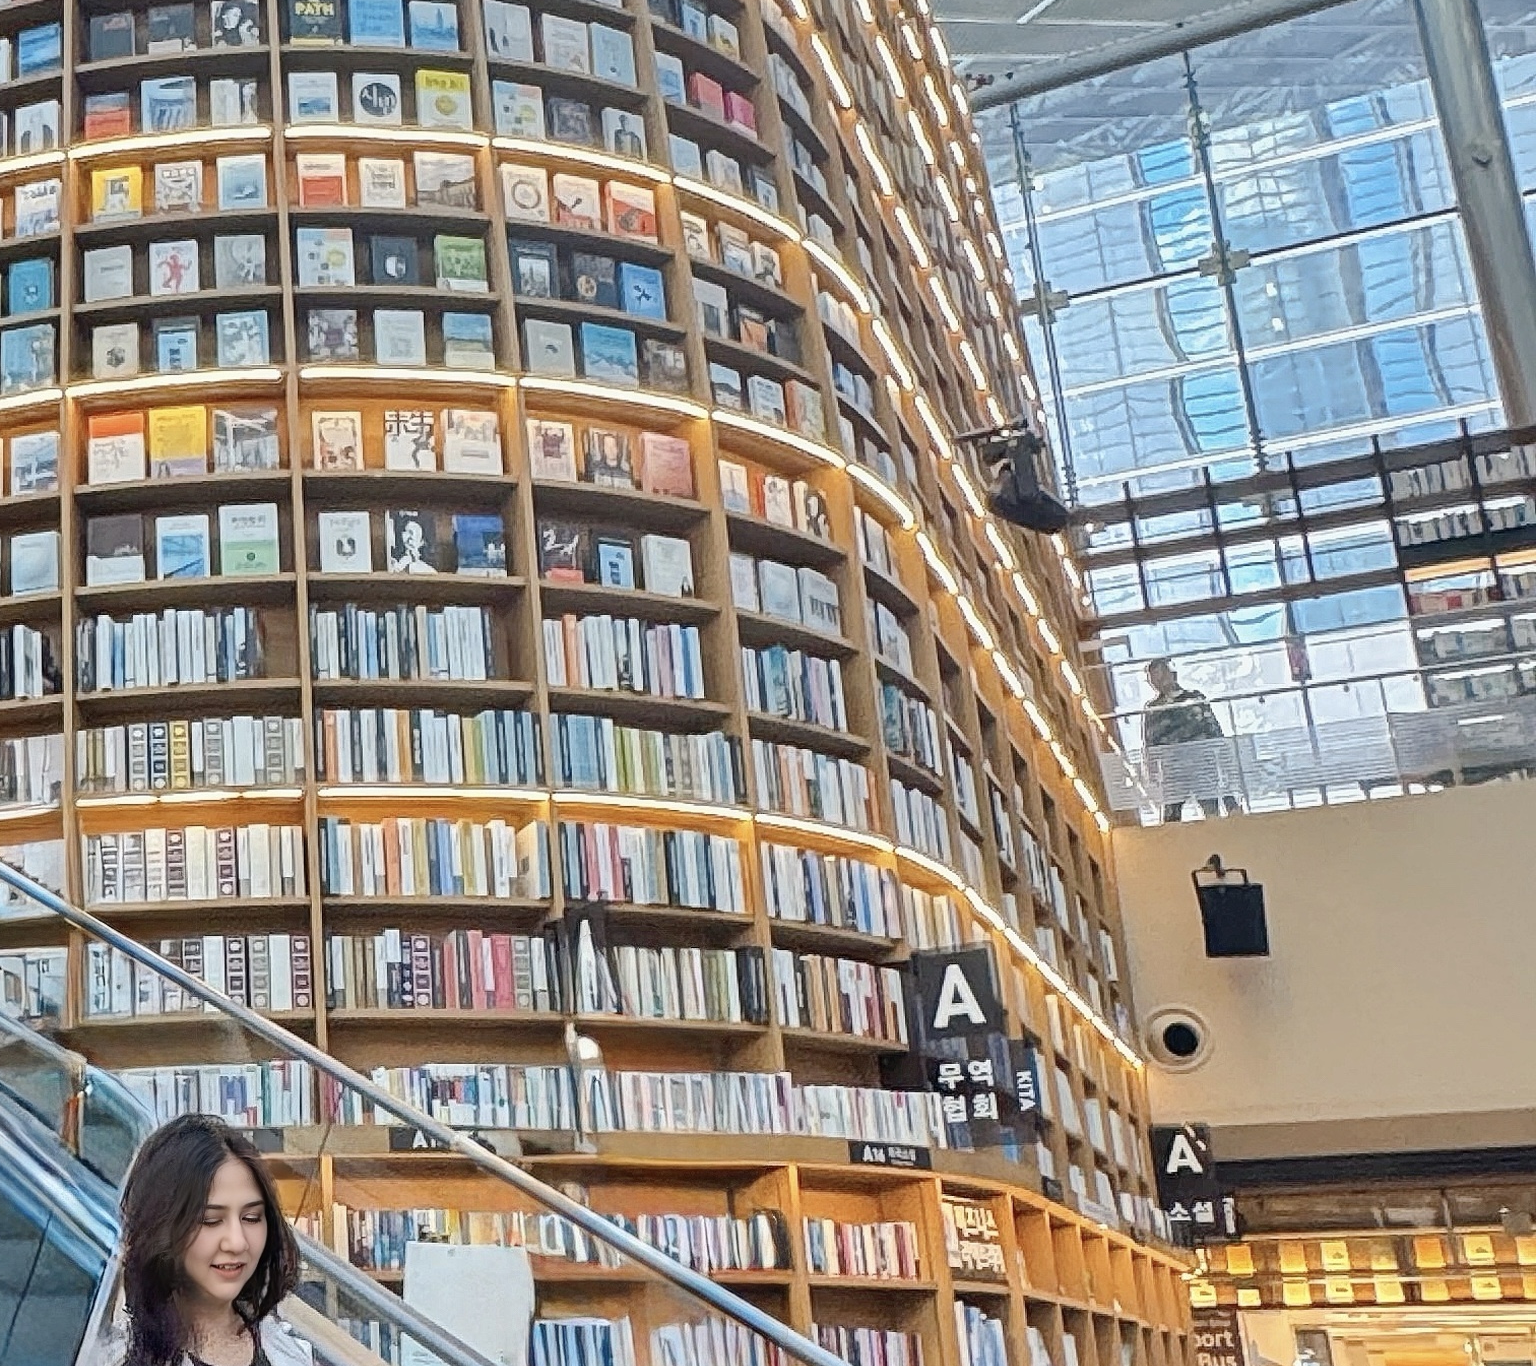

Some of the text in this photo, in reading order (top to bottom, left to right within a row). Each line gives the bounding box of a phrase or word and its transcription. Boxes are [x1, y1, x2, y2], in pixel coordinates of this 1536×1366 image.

[932, 963, 987, 1030] A
[937, 1059, 995, 1090] 무역
[1015, 1070, 1037, 1112] KITA
[1166, 1134, 1204, 1175] A
